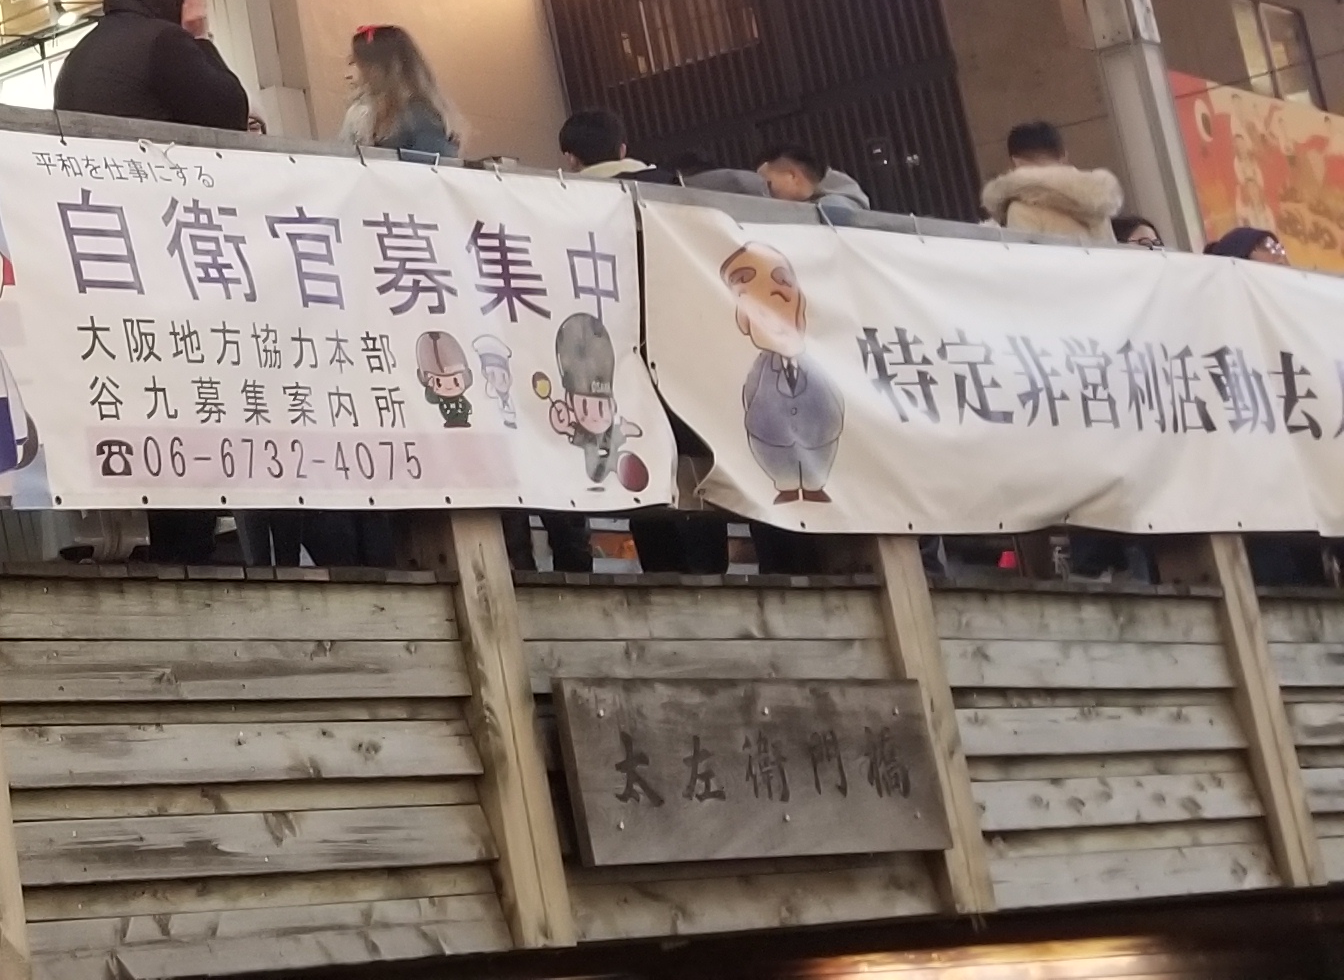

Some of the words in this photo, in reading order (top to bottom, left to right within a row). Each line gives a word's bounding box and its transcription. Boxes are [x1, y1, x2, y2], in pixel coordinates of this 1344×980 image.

[32, 152, 214, 188] 平和を仕事にする
[57, 189, 621, 323] 自衛官募集中
[77, 315, 398, 375] 大阪地方協力本部
[88, 375, 407, 429] 谷九募集案内所
[143, 436, 423, 481] 06-6732-4075
